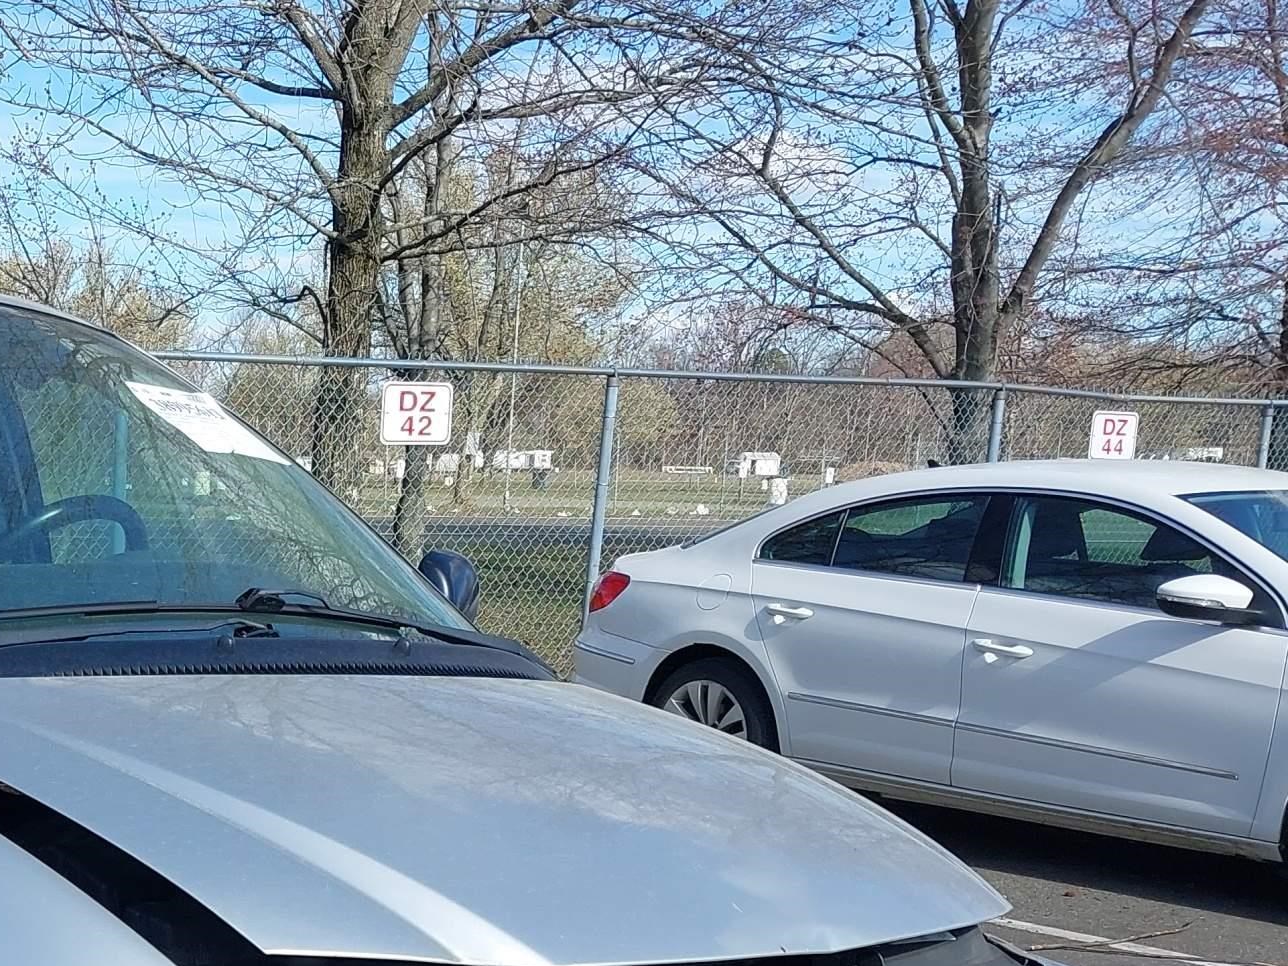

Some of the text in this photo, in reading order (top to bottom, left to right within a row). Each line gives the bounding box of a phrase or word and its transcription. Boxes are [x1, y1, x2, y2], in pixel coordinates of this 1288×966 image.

[399, 390, 436, 412] DZ
[400, 416, 432, 436] 42
[1103, 418, 1129, 436] DZ
[1101, 438, 1123, 455] 44
